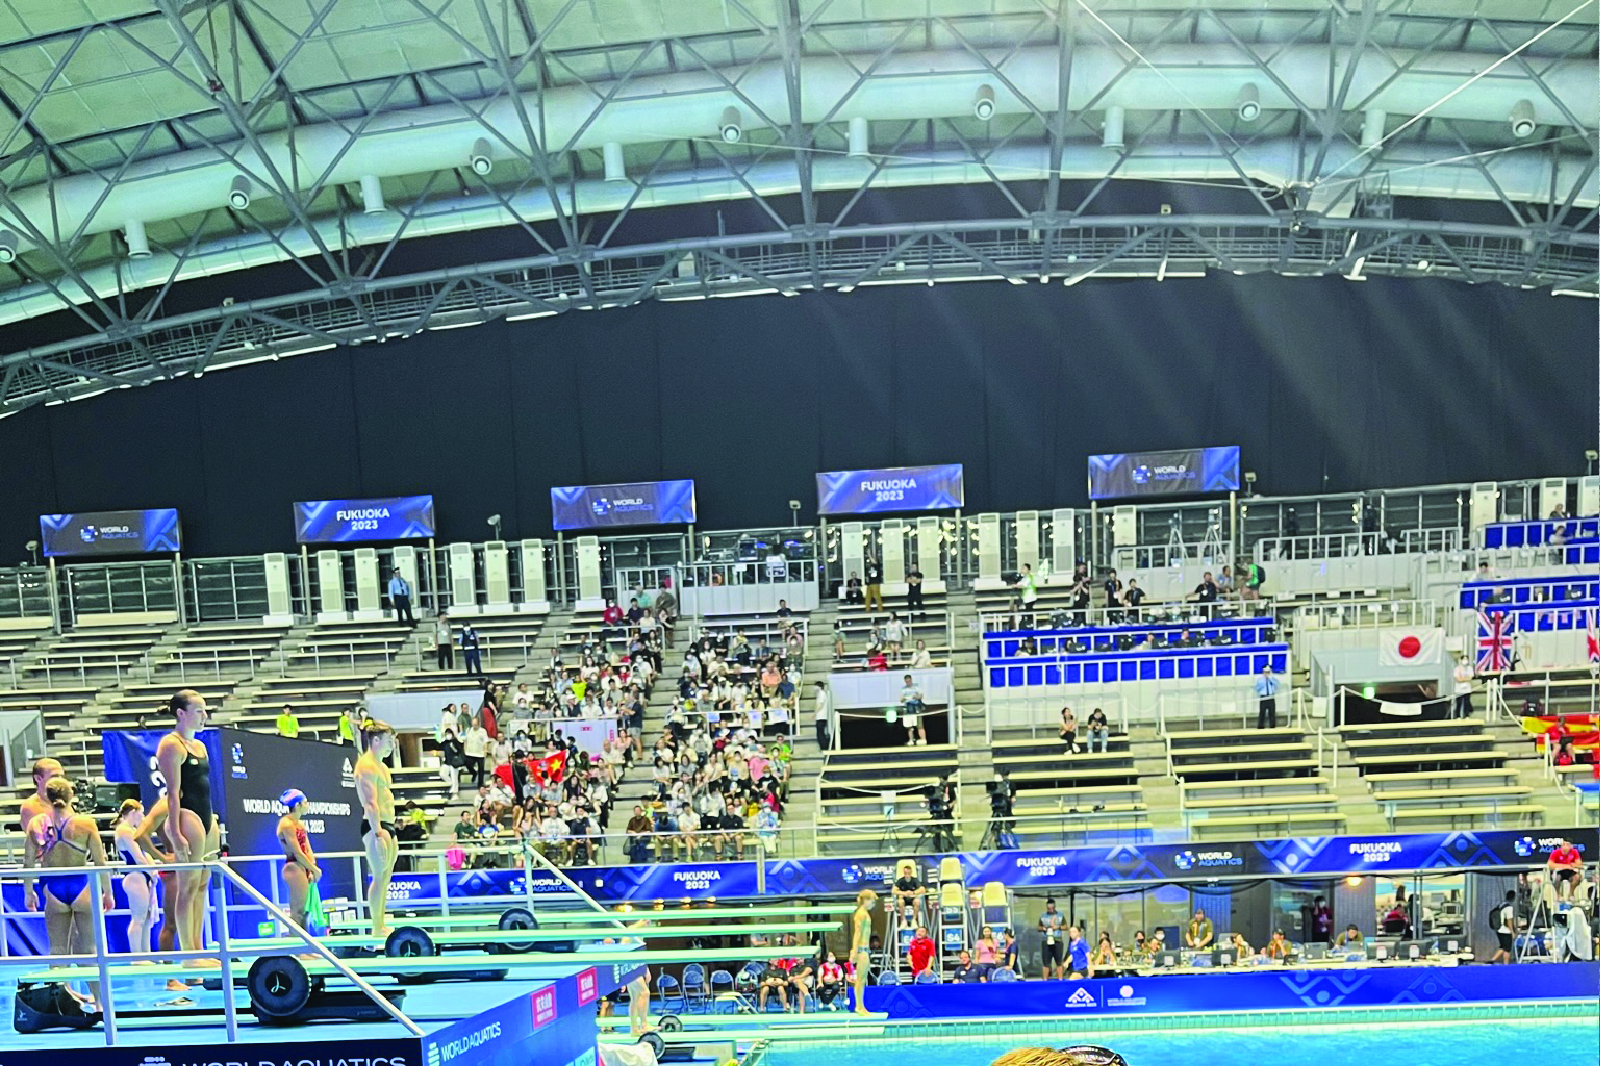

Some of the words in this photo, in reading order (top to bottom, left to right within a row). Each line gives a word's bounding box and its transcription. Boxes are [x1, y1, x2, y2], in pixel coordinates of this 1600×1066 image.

[1154, 465, 1187, 474] WORLD
[860, 479, 917, 492] FUKUOKA
[876, 490, 904, 501] 2023
[613, 498, 643, 506] WORLD
[336, 508, 390, 521] FUKUOKA
[100, 526, 129, 534] WORLD
[351, 520, 378, 530] 2023
[243, 799, 271, 814] WORLD
[307, 802, 350, 816] HAMPIONSHIPS
[1349, 842, 1401, 853] FUKUOKA
[1198, 851, 1233, 860] WORLD
[1363, 853, 1390, 862] 2023
[1016, 857, 1067, 867] FUKUOKA
[1199, 858, 1243, 867] AQUATICS
[674, 870, 721, 882] FUKUOKA
[1030, 866, 1056, 876] 2023
[685, 880, 710, 889] 2023
[441, 1038, 468, 1062] WORLD
[469, 1021, 501, 1048] AQUATICS
